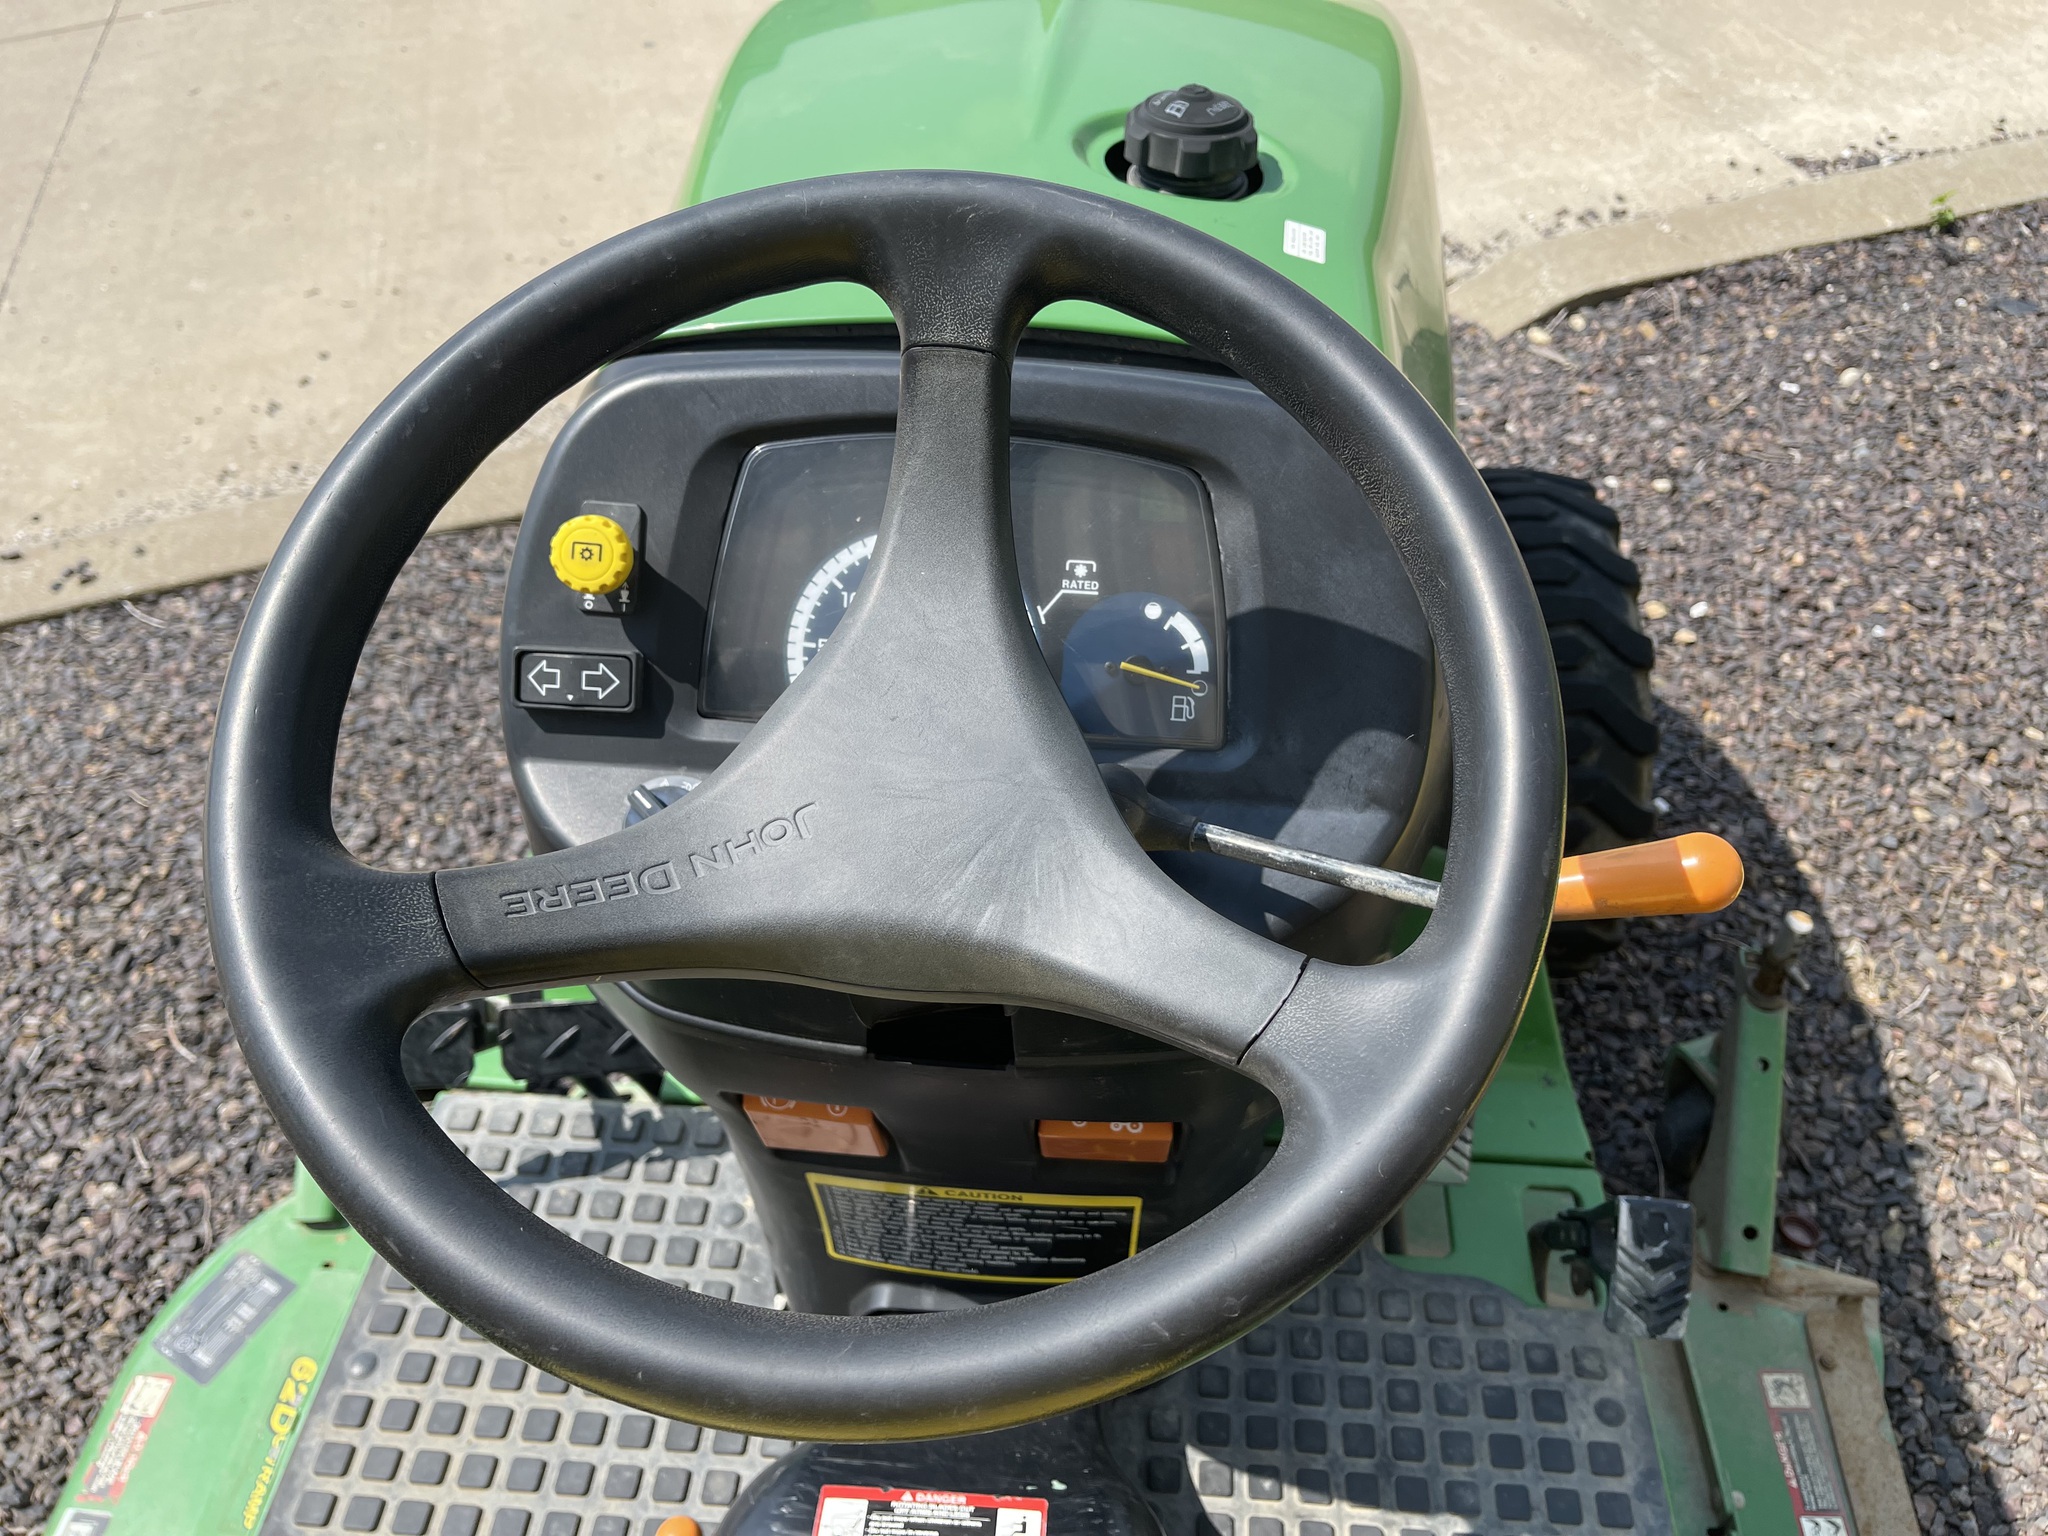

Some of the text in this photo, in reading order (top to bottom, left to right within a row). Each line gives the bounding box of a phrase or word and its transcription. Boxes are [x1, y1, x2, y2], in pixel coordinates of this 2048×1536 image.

[1062, 579, 1099, 590] RATED
[500, 800, 818, 918] JOHN DEERE
[944, 1189, 1024, 1201] CAUTION
[915, 1491, 967, 1505] DANGER
